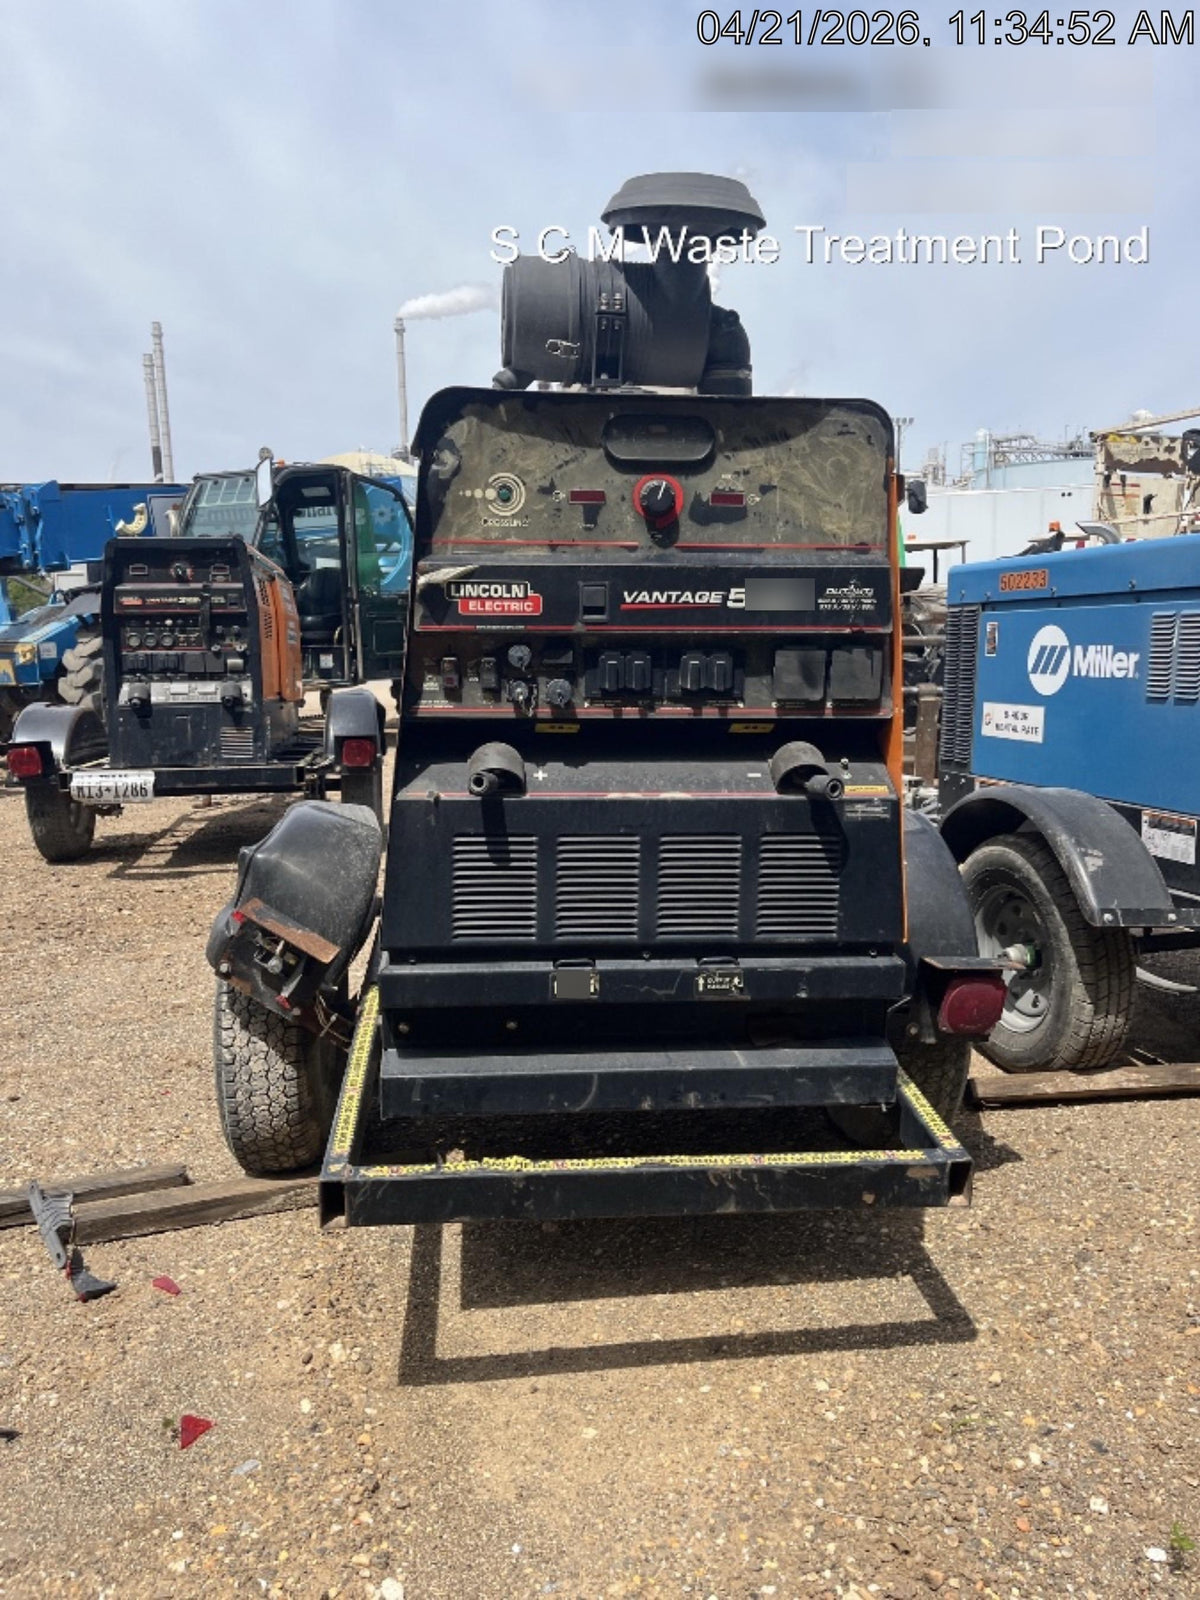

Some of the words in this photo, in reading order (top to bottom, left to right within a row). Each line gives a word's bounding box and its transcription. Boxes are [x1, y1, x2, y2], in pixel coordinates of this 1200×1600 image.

[1000, 569, 1047, 591] 502233
[450, 584, 526, 598] LINCOLN
[623, 591, 724, 604] VANTAGE
[468, 600, 534, 612] ELECTRIC
[1073, 644, 1140, 679] Miller
